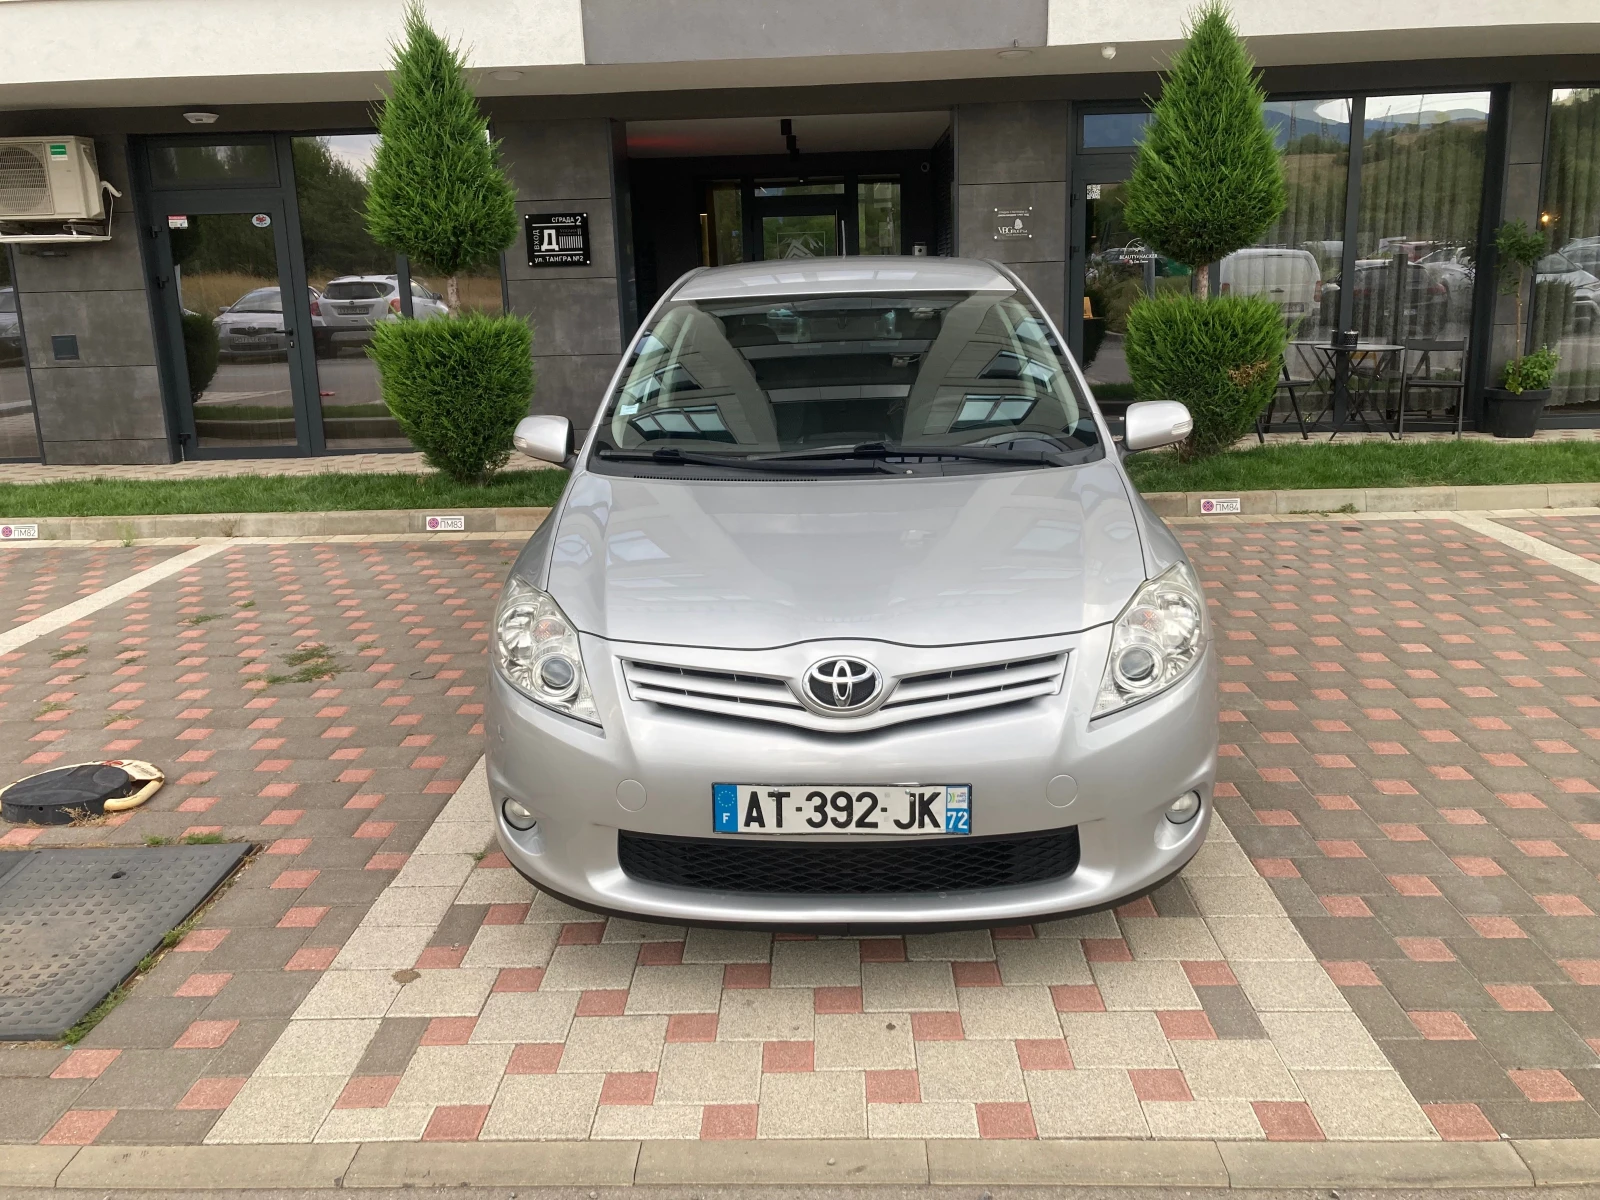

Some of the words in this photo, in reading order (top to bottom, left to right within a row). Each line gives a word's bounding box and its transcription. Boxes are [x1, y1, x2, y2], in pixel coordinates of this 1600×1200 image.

[575, 216, 582, 225] 2
[532, 229, 540, 250] ВХОД
[540, 228, 559, 251] Д
[722, 812, 731, 824] F
[946, 811, 968, 829] 72
